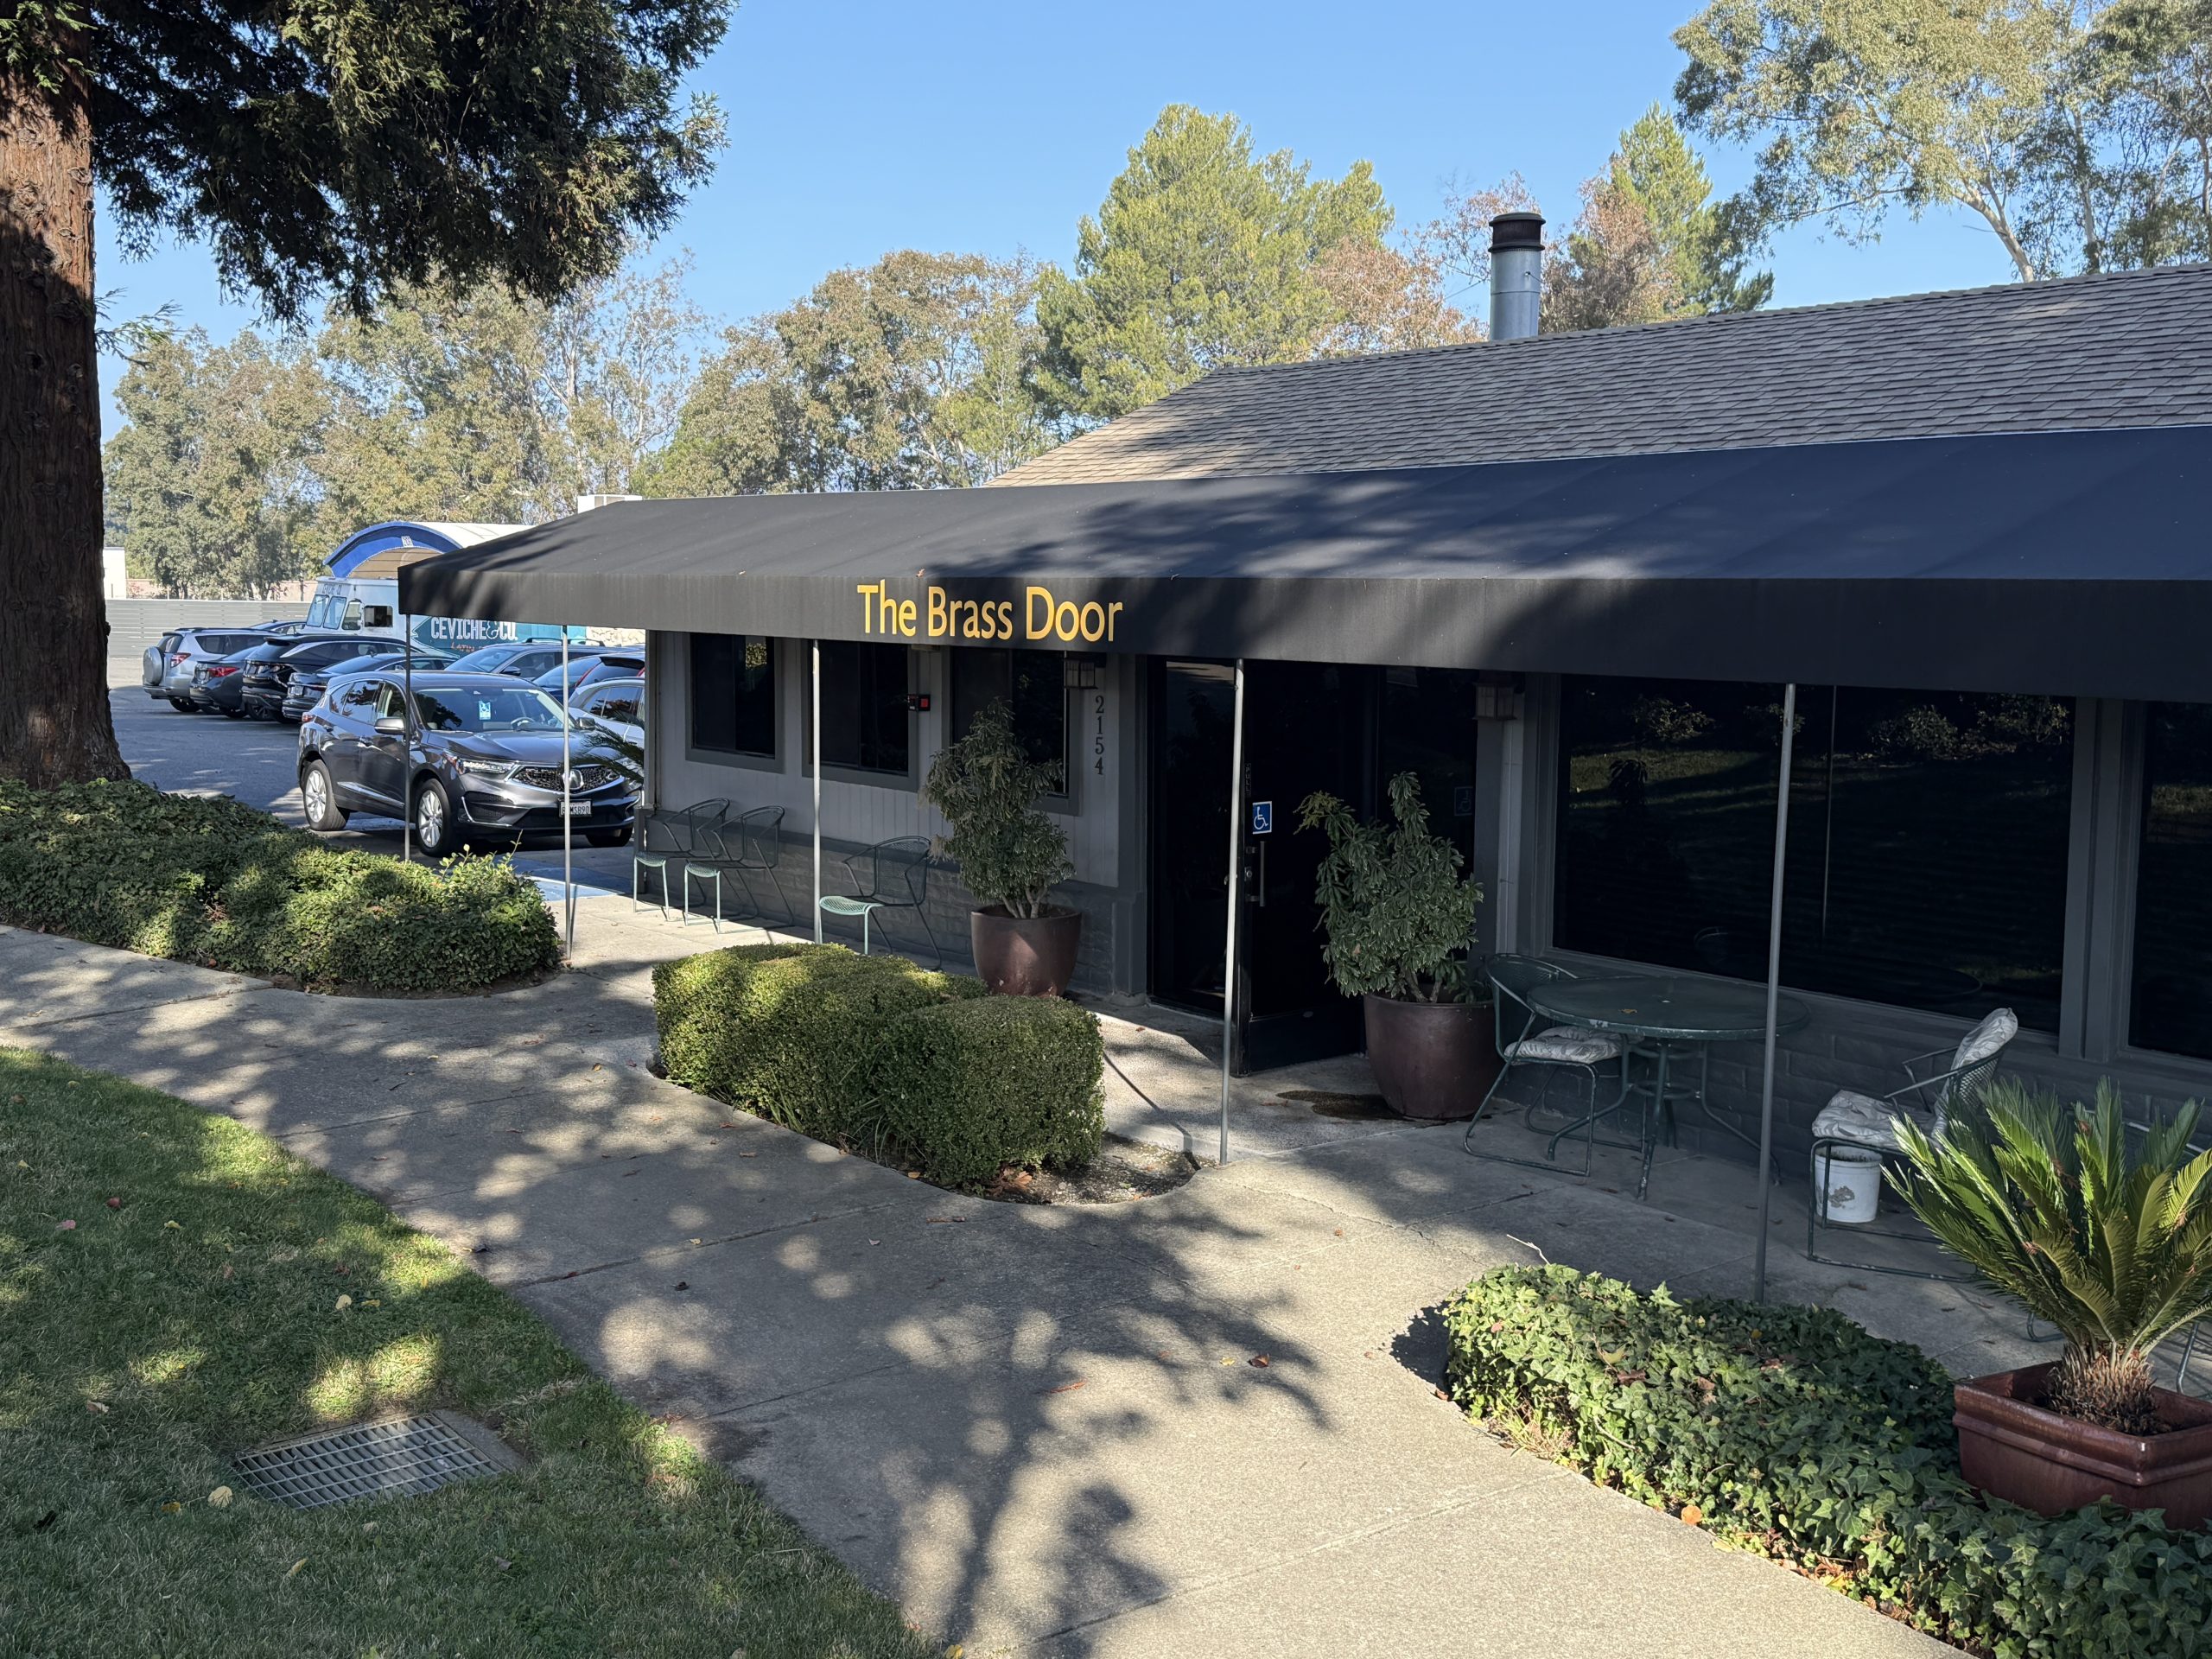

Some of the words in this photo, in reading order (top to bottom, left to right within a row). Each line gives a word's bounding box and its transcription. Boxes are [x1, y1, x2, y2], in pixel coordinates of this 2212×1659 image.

[857, 579, 917, 637] The
[928, 586, 1013, 640] Brass
[1027, 586, 1123, 642] Door
[1095, 695, 1104, 775] 2154
